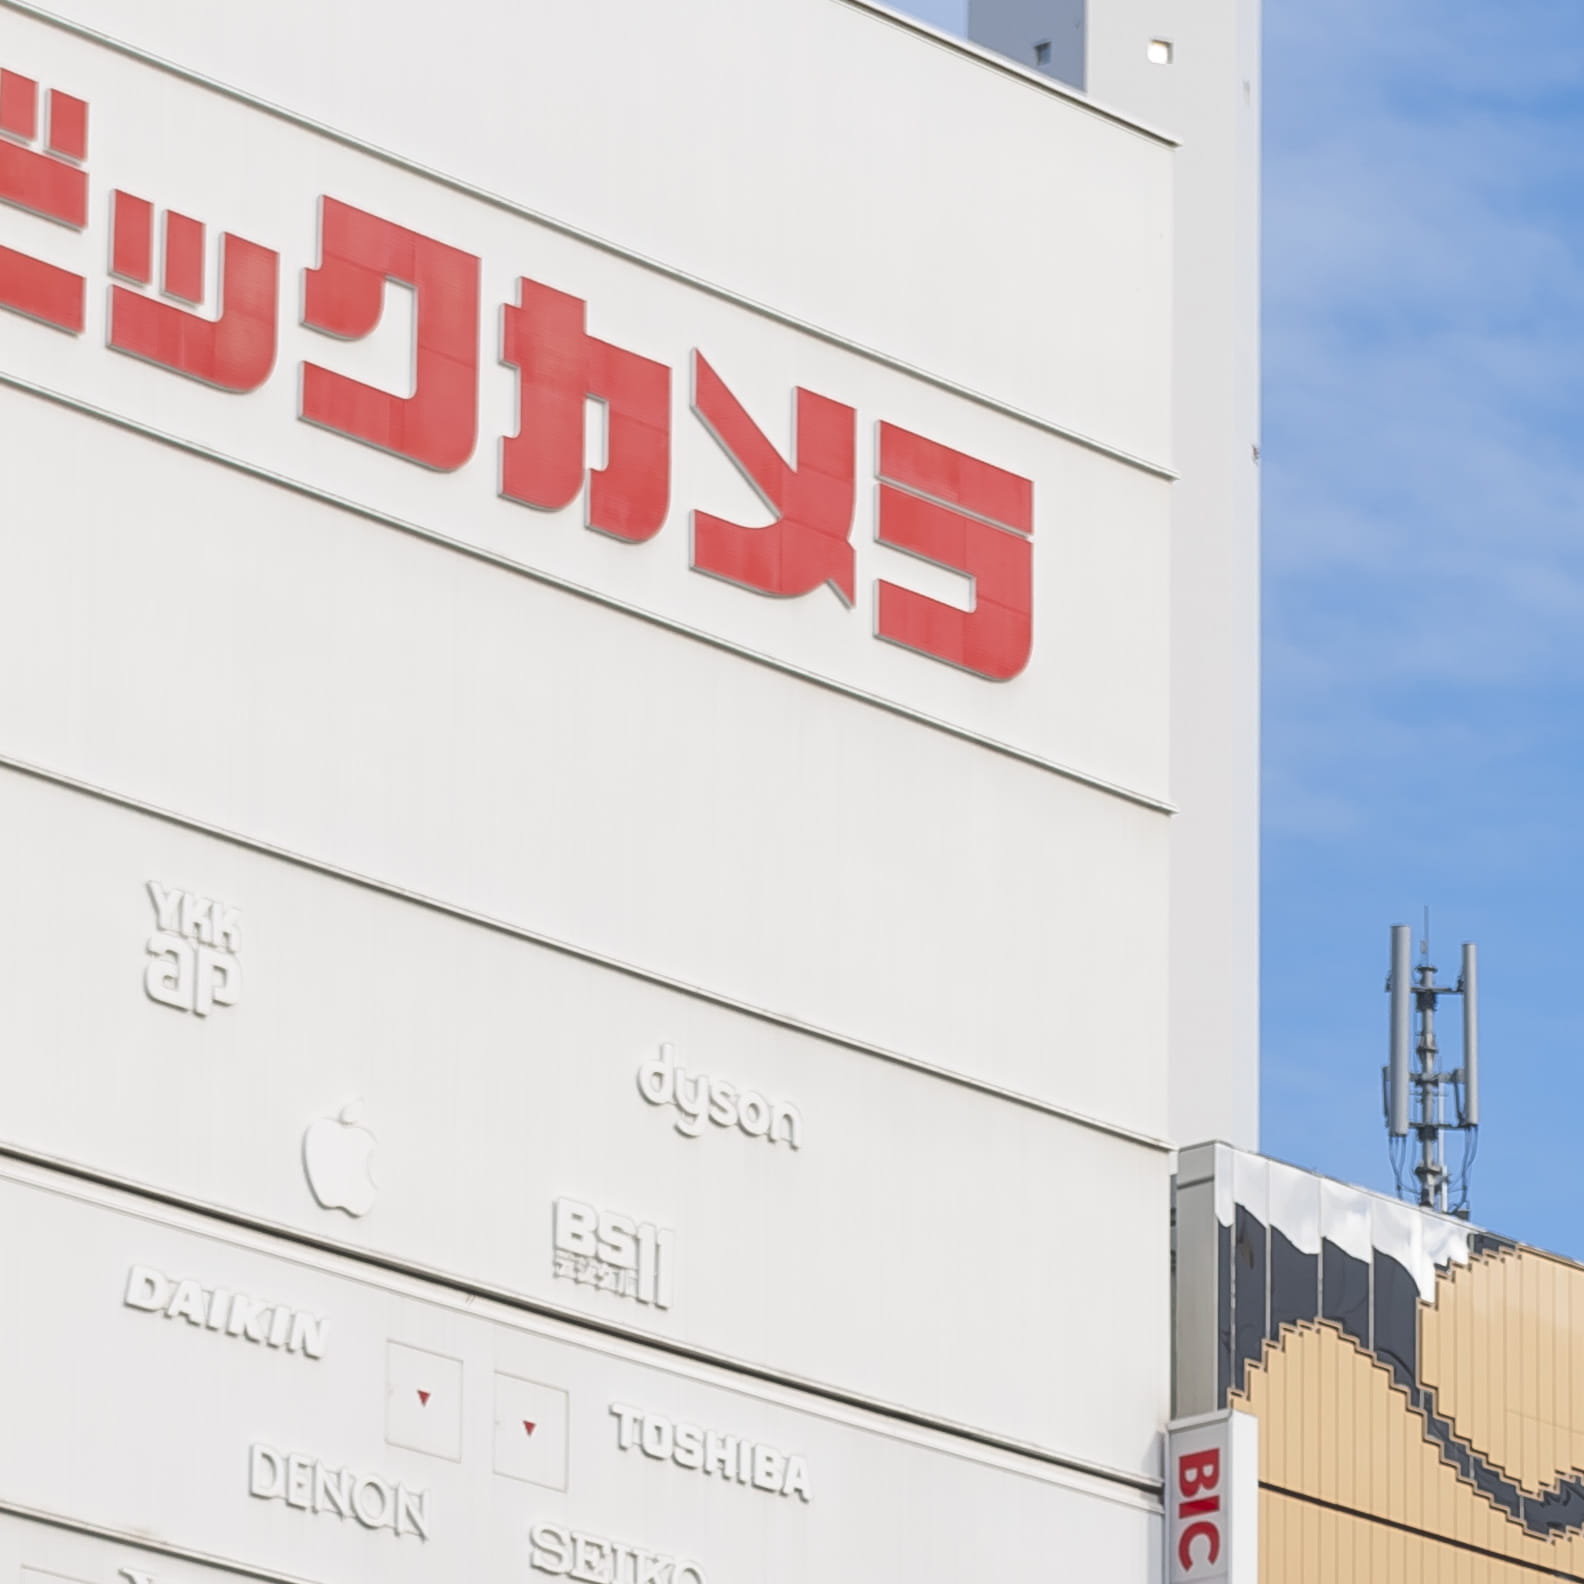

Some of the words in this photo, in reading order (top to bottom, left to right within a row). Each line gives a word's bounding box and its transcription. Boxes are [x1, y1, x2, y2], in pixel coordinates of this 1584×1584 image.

[146, 880, 243, 952] YKK
[144, 934, 243, 1017] ap
[635, 1044, 804, 1151] dyson
[124, 1263, 332, 1361] DAIKIN
[249, 1442, 431, 1541] DENON
[609, 1402, 815, 1503] TOSHIBA
[1178, 1448, 1221, 1573] BIC
